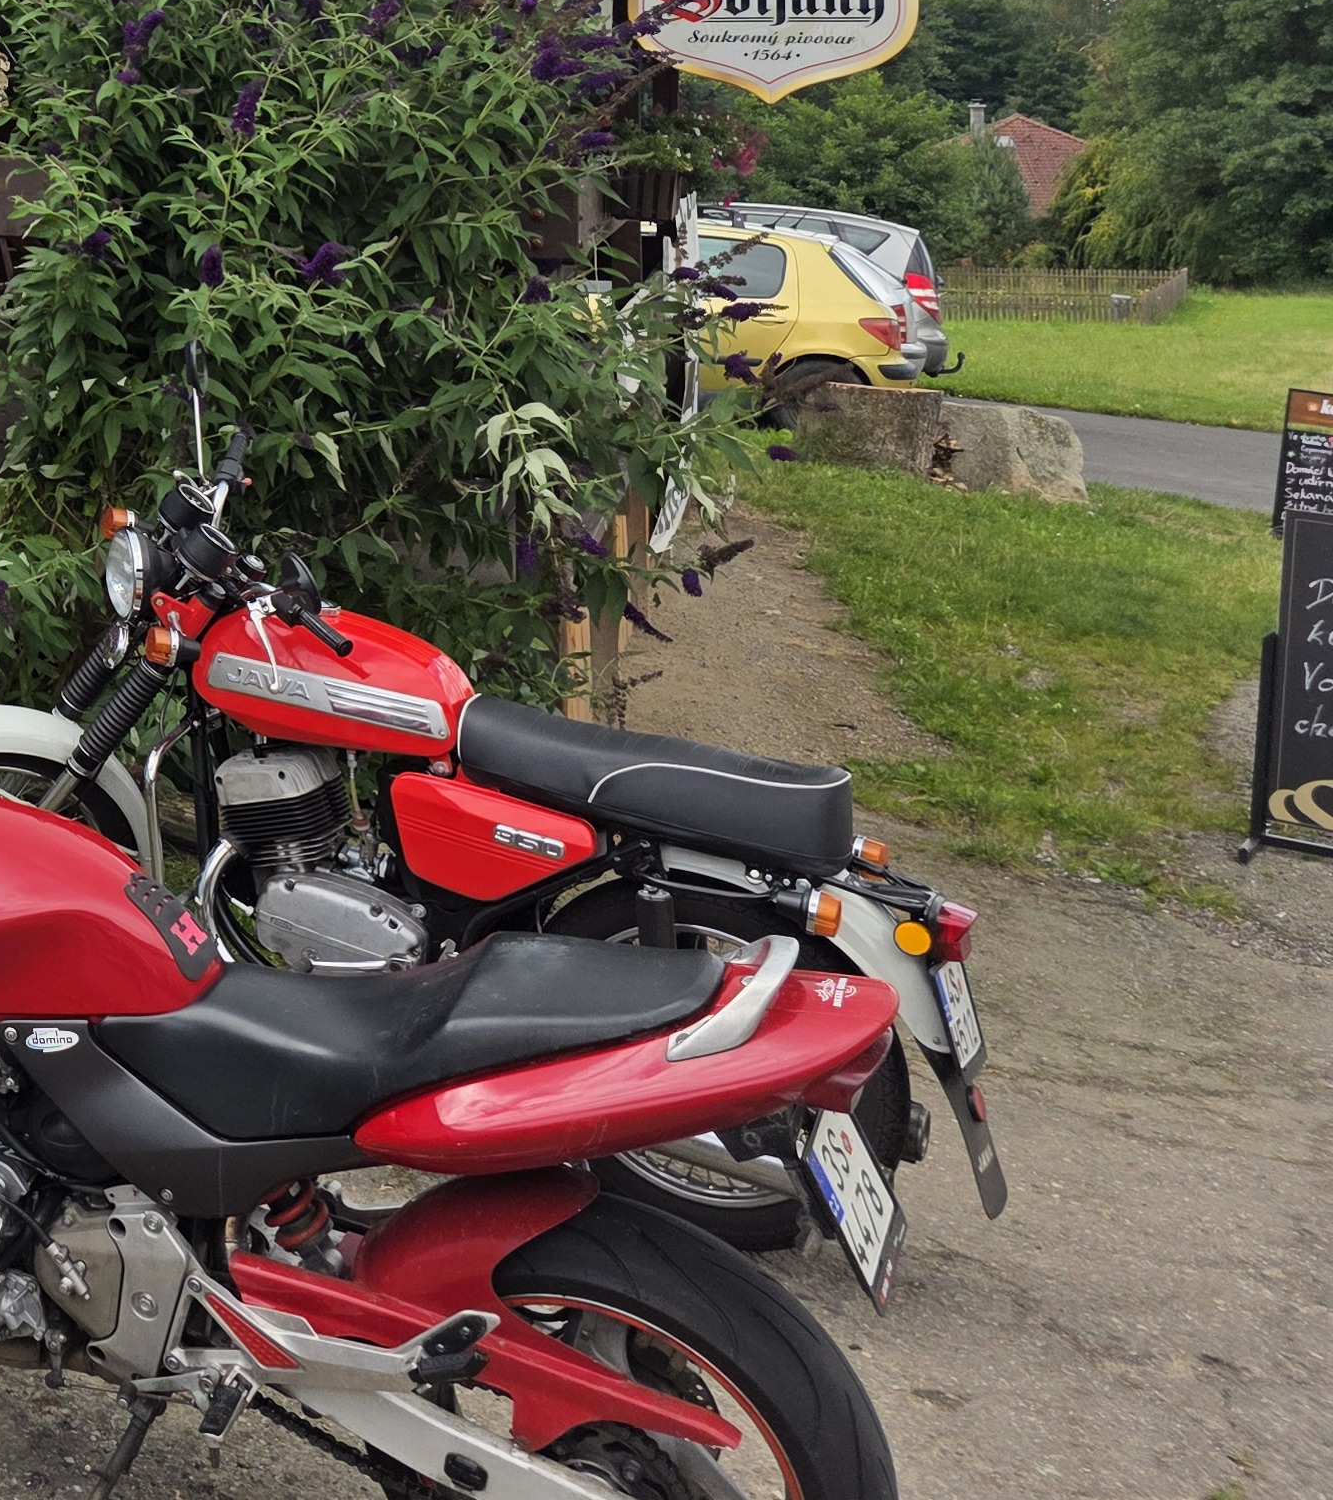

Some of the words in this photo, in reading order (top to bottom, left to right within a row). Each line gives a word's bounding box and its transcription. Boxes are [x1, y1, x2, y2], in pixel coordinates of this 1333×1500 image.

[687, 29, 779, 47] Soukromý
[784, 31, 856, 47] pivovar
[752, 49, 793, 62] 1564
[32, 1030, 73, 1045] domino
[821, 1128, 850, 1191] 3S
[845, 1168, 884, 1266] 4478
